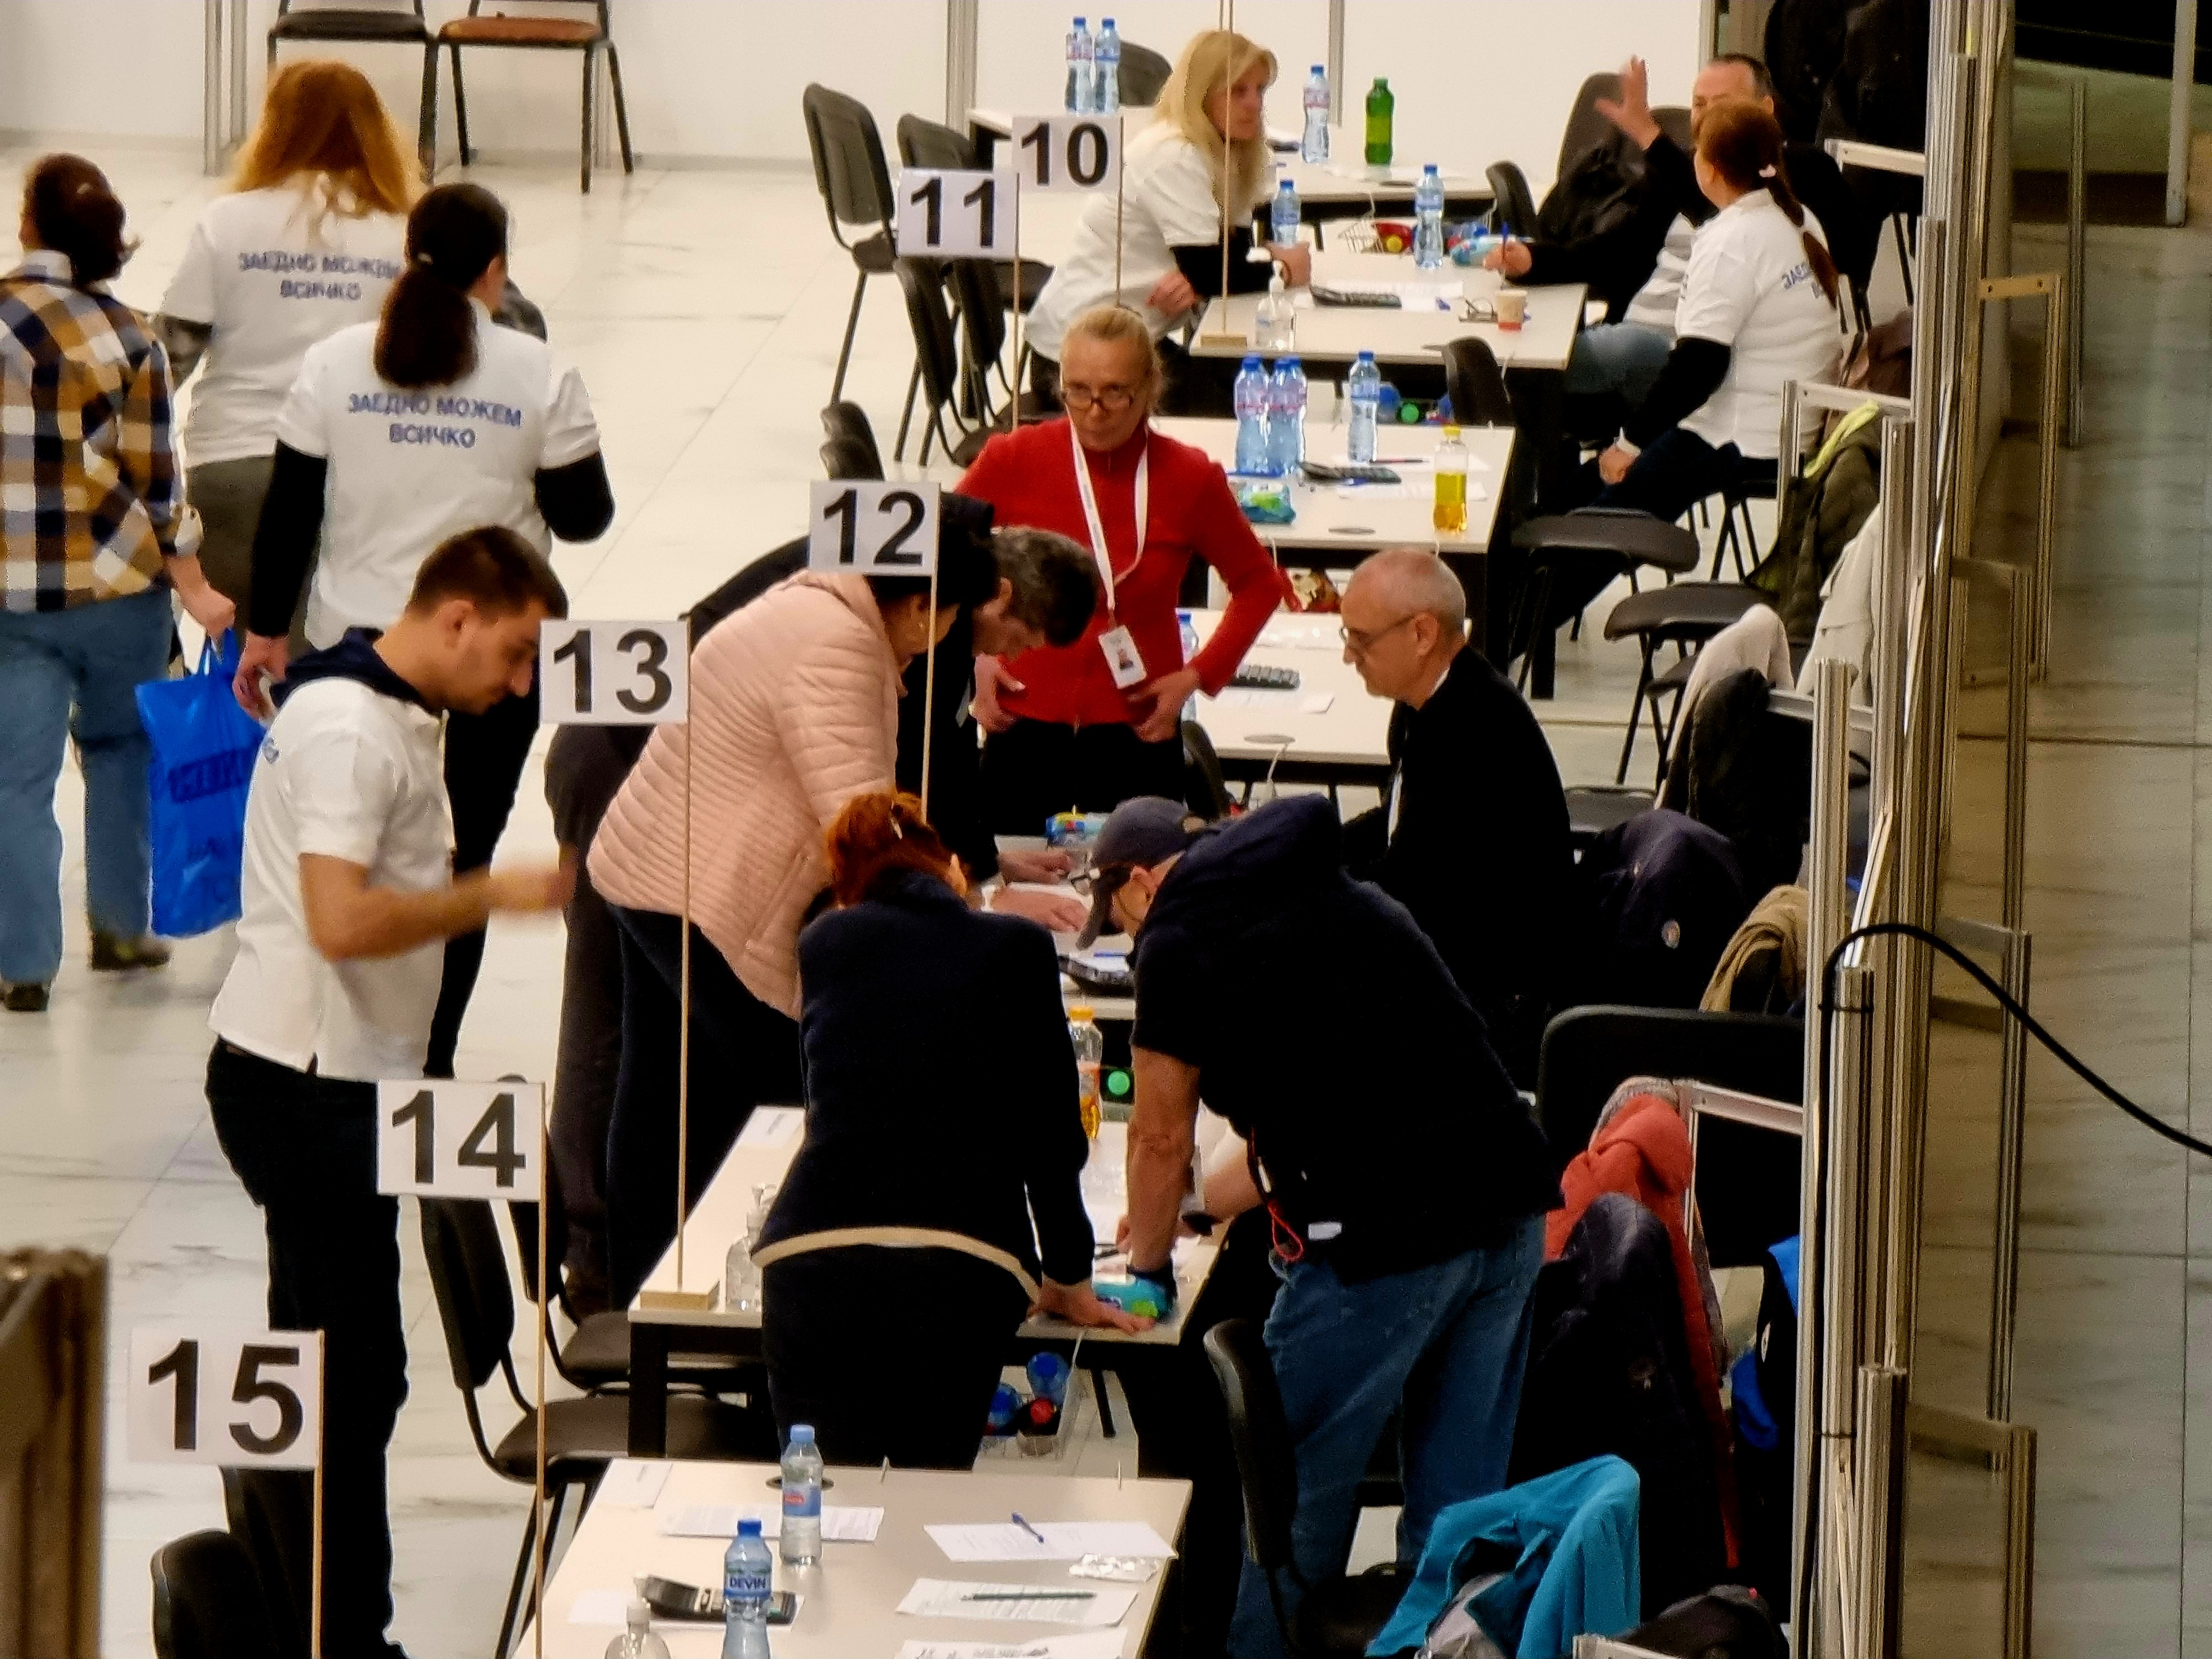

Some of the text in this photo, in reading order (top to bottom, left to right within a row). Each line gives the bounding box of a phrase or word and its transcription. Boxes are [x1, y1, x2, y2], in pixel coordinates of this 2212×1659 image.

[1021, 121, 1107, 187] 10
[910, 176, 995, 249] 11
[238, 251, 316, 273] ЗАЕДНО
[348, 393, 522, 427] ЗАЕДНО МОЖЕМ
[389, 424, 476, 448] ВСИЧКО
[823, 489, 925, 566] 12
[554, 628, 672, 714] 13
[392, 1090, 526, 1188] 14
[148, 1339, 303, 1455] 15
[729, 1577, 766, 1589] DEVIN
